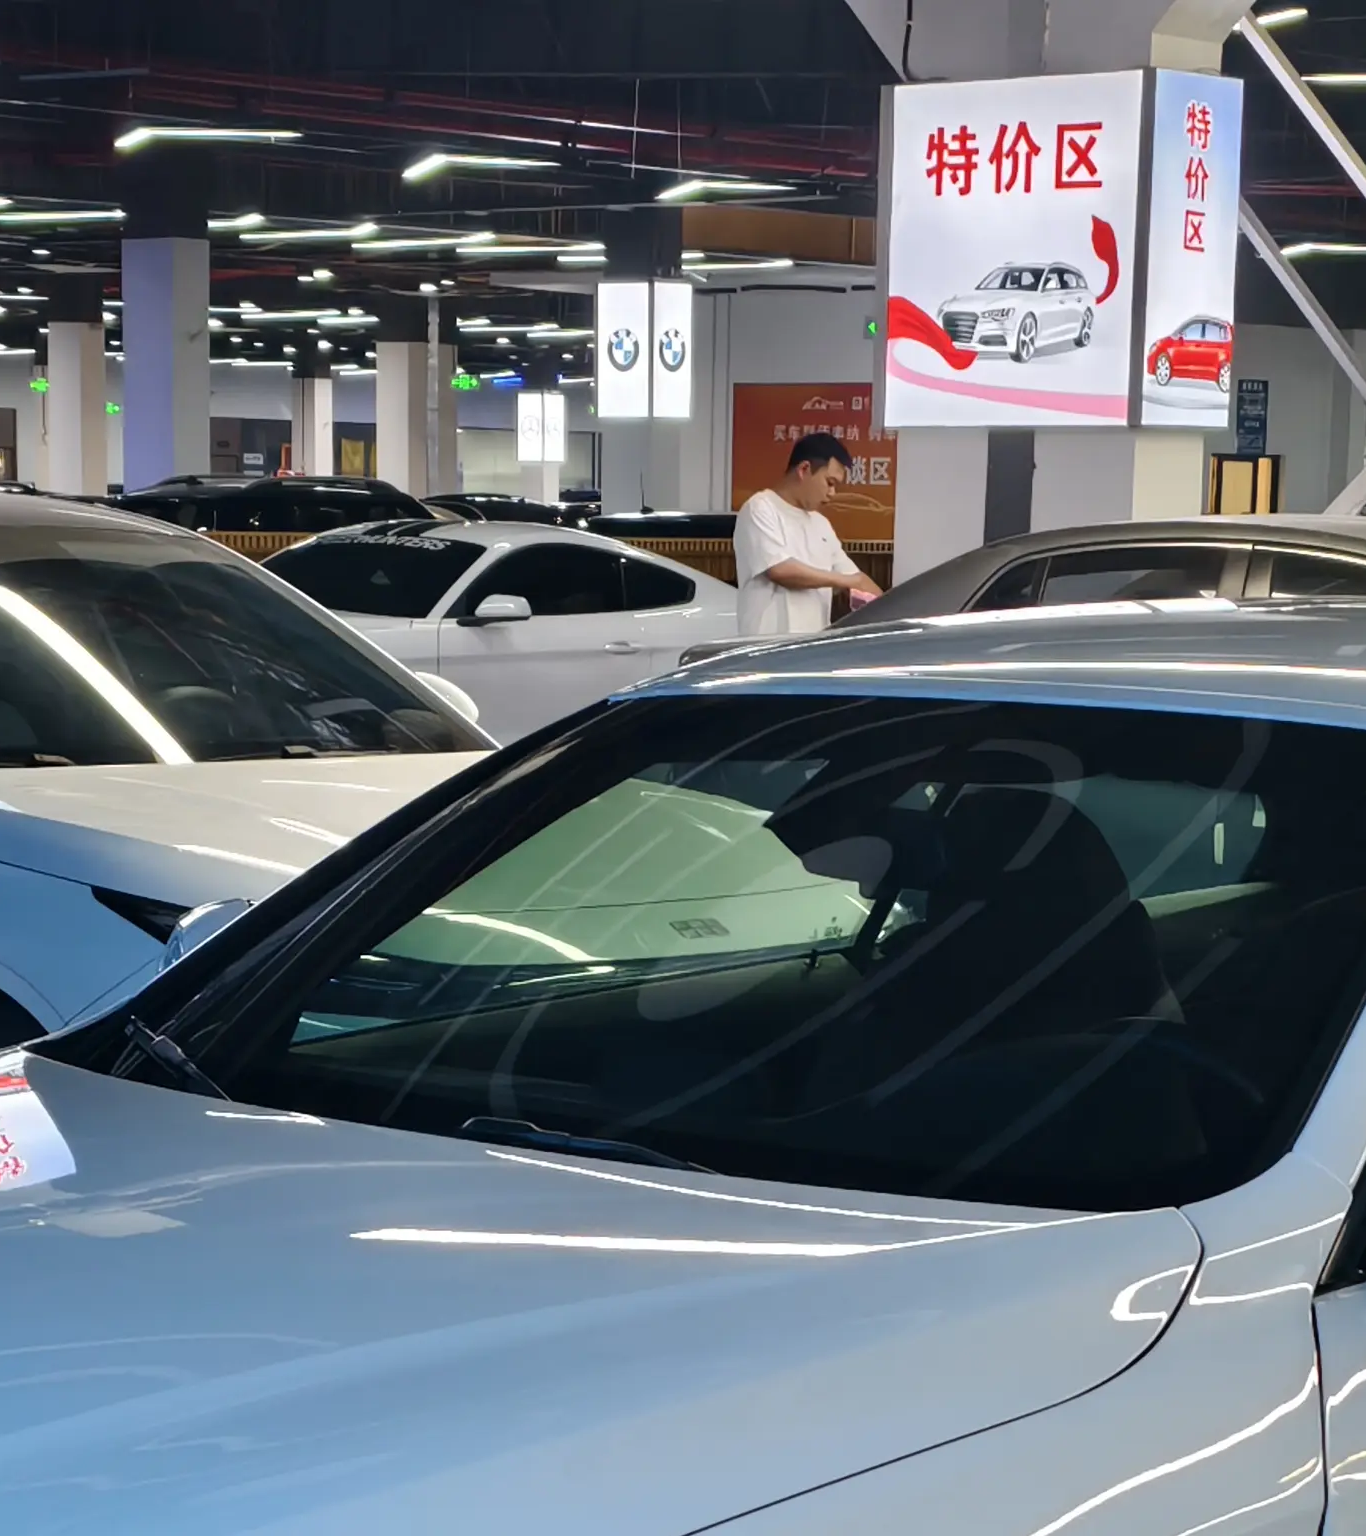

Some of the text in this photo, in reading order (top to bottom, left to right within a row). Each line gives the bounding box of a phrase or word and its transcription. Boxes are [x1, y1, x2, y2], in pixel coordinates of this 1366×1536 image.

[925, 120, 1103, 196] 特价区
[1184, 101, 1212, 253] 特价区
